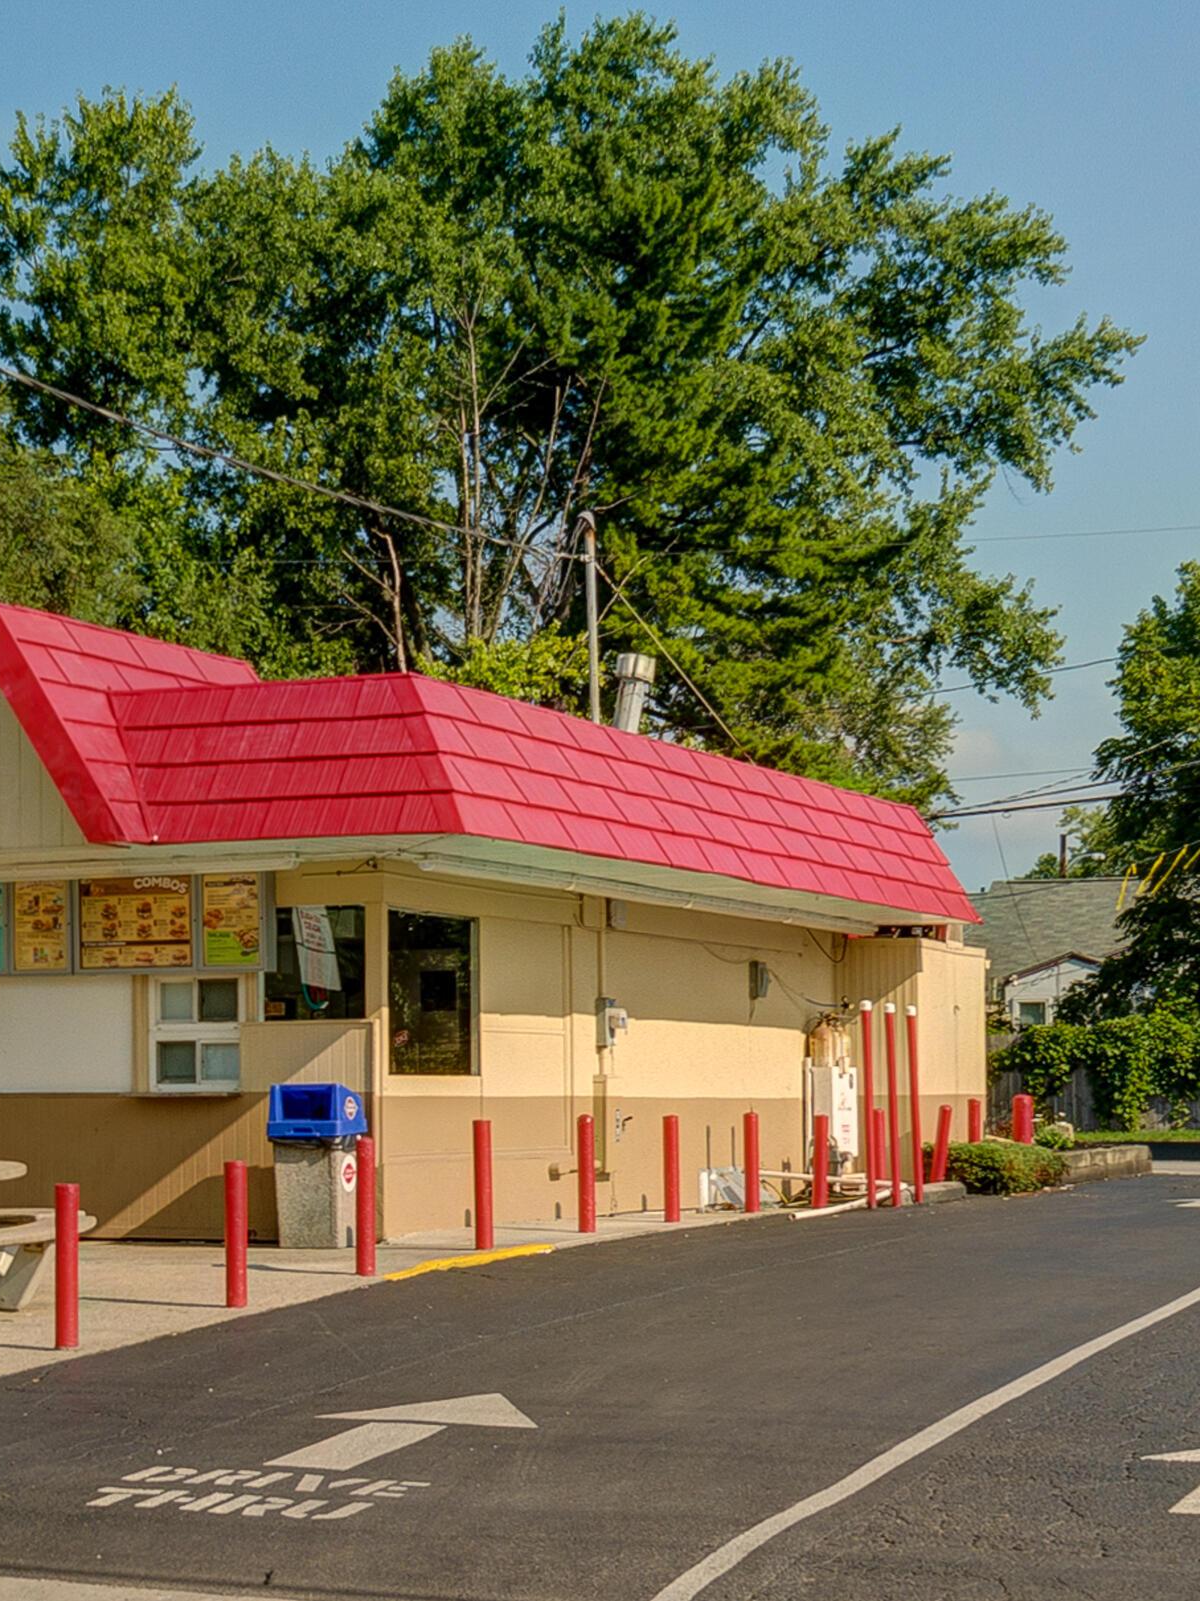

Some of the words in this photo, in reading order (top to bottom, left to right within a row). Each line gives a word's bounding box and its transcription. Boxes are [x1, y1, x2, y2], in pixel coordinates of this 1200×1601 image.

[133, 876, 188, 894] COMBOS
[120, 1465, 432, 1497] DRIVE
[85, 1486, 375, 1520] THRU
